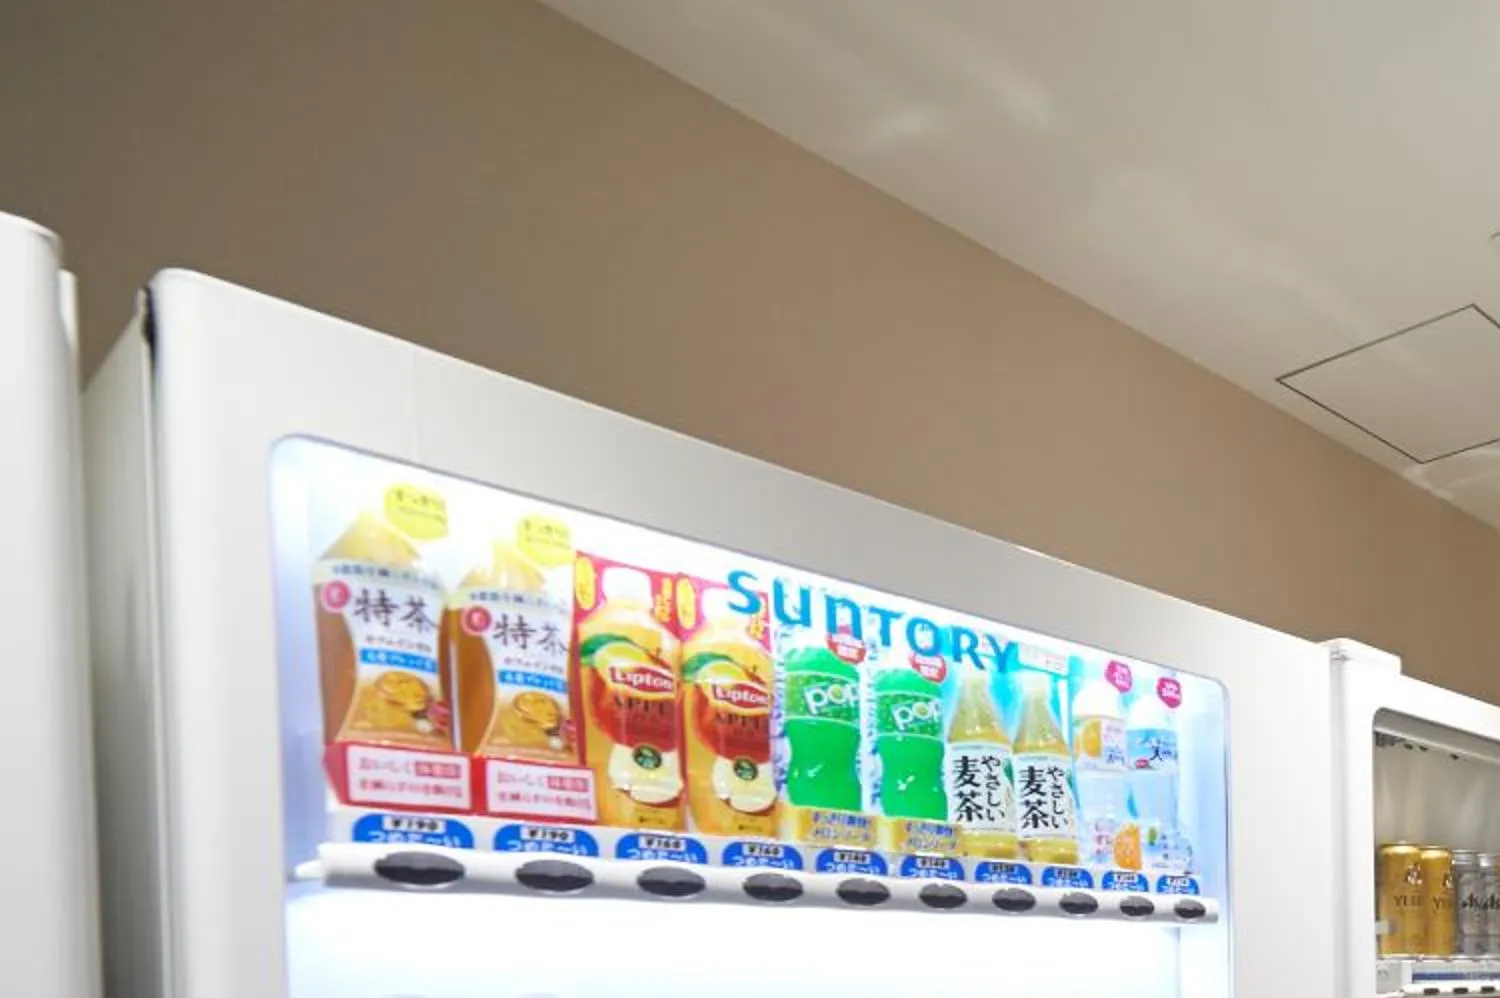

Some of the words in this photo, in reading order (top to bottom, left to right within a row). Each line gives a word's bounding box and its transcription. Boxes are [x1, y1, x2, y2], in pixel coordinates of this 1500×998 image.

[354, 588, 438, 633] 特茶
[493, 613, 568, 653] 特茶
[727, 569, 1019, 673] SUNTORY
[954, 755, 983, 822] 麦茶
[981, 755, 1005, 821] やさしい
[1020, 765, 1048, 829] 麦茶
[1047, 766, 1069, 829] やさしい
[391, 818, 438, 832] ¥190
[528, 828, 568, 841] ¥190
